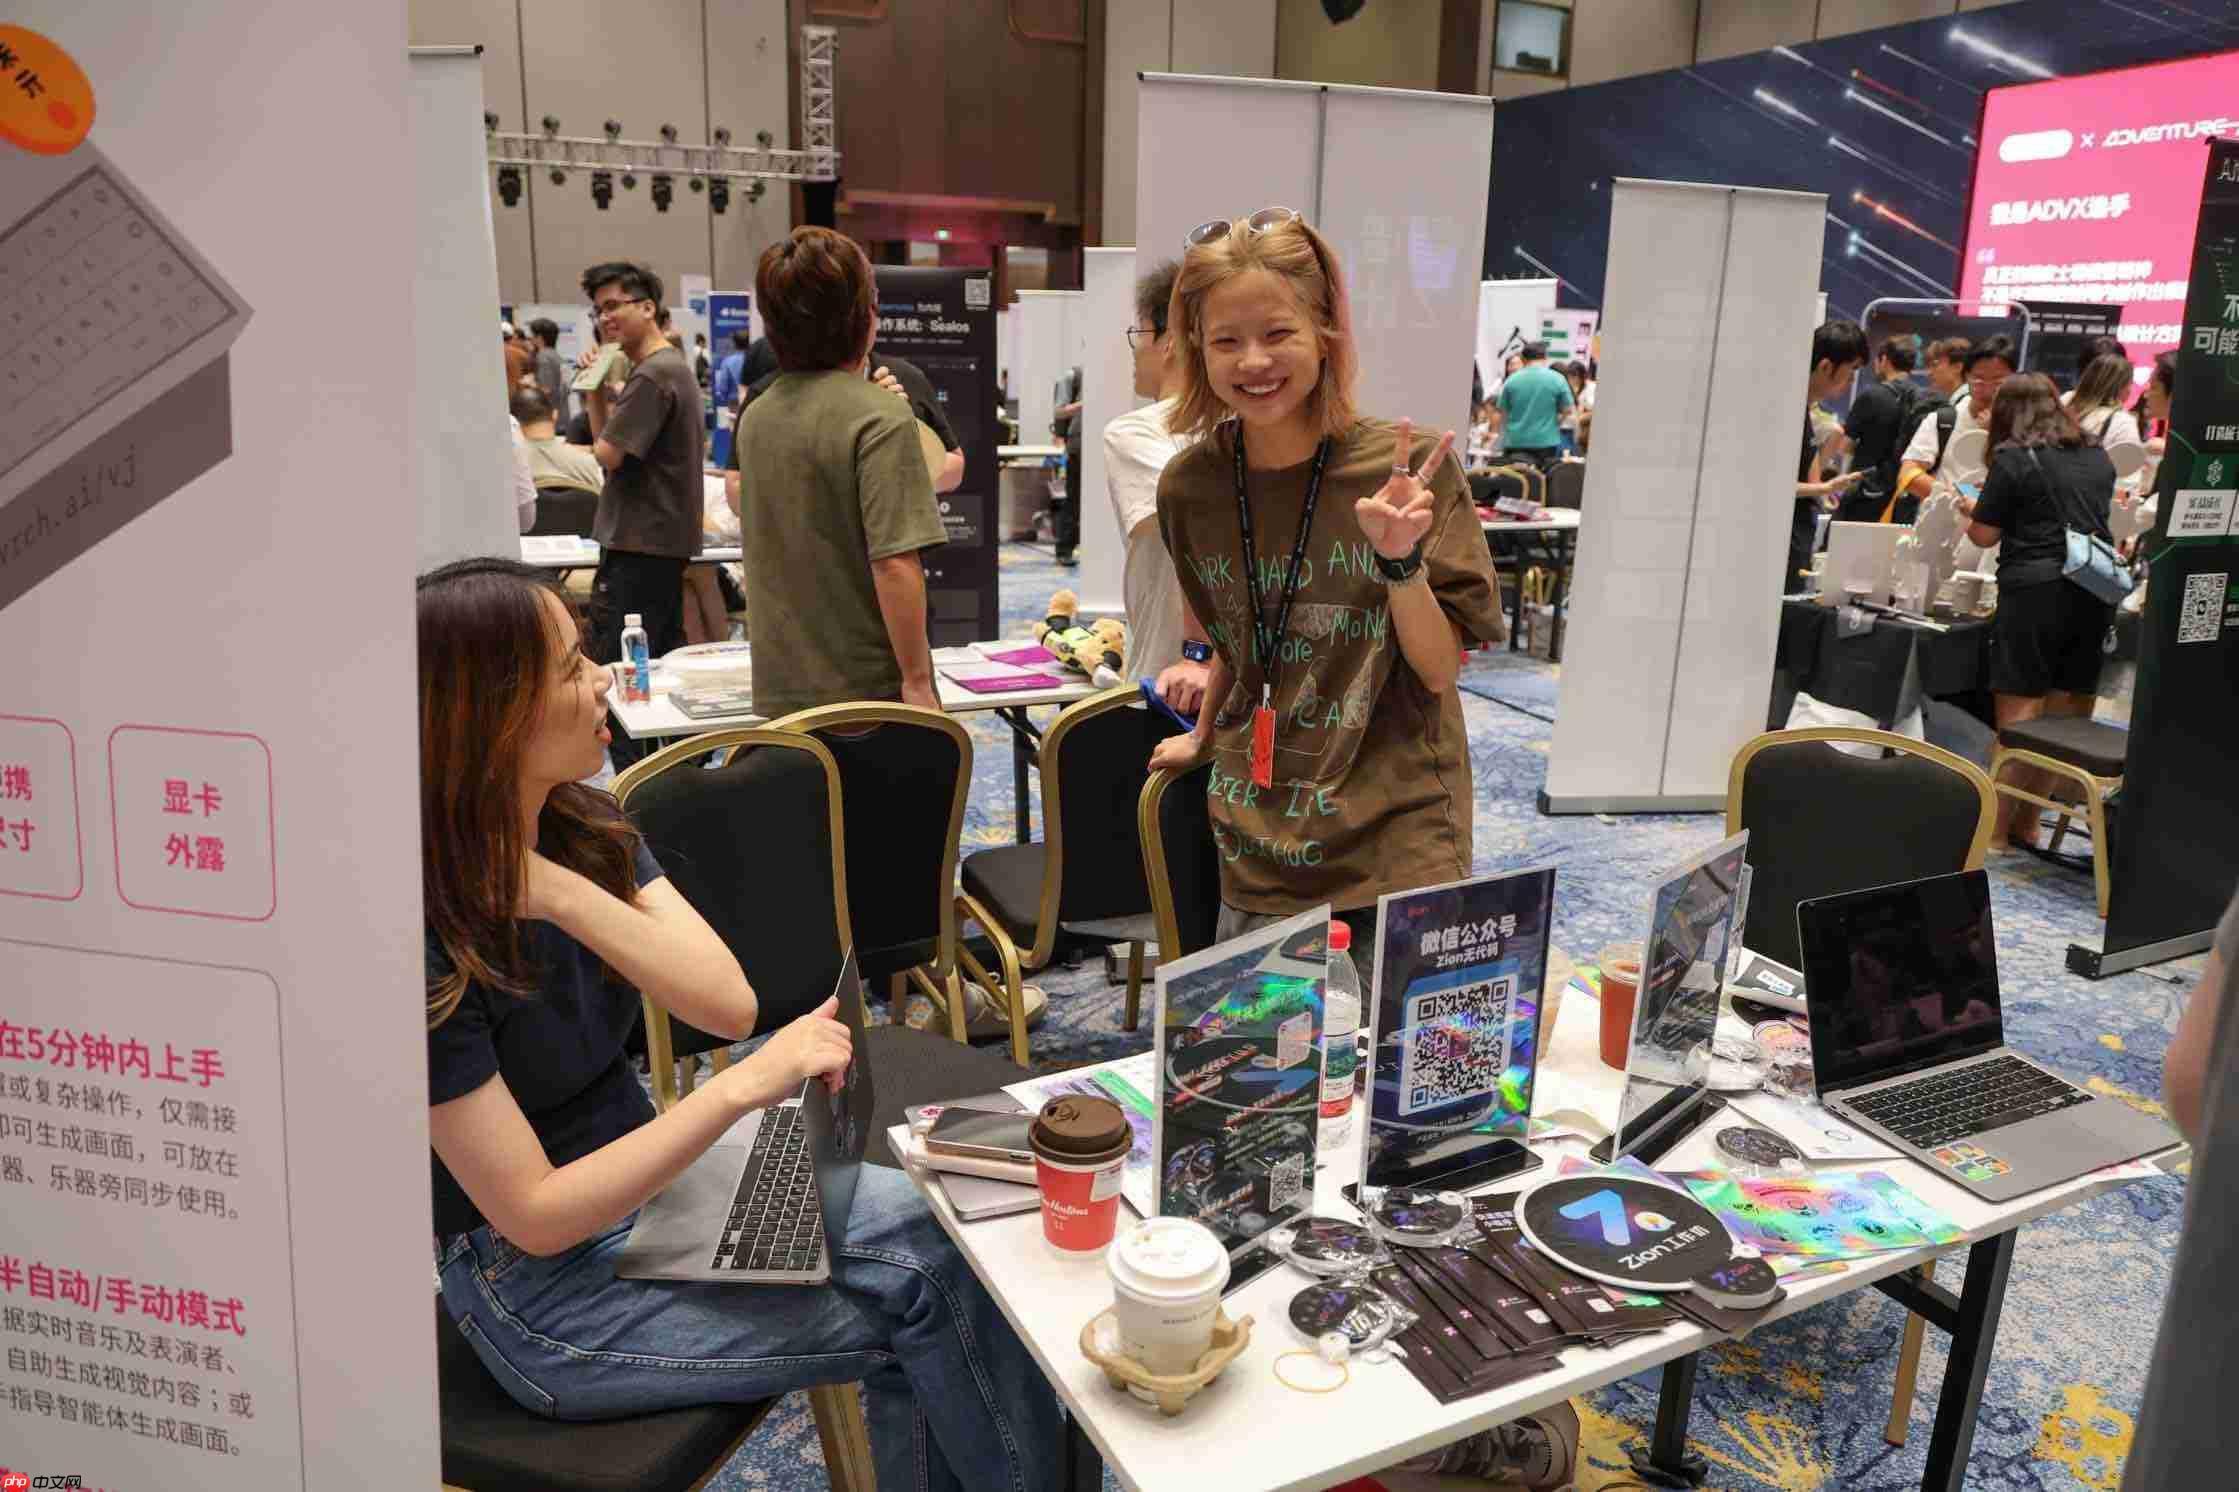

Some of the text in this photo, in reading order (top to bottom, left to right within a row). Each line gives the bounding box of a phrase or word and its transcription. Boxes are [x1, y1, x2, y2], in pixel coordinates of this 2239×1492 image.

[0, 764, 33, 801] 携
[162, 778, 223, 818] 显卡
[164, 832, 225, 873] 外露
[1420, 913, 1517, 957] 微信公众号
[0, 1072, 238, 1136] 或复杂操作，仅需接
[0, 1383, 240, 1457] 指导智能体生成画面。
